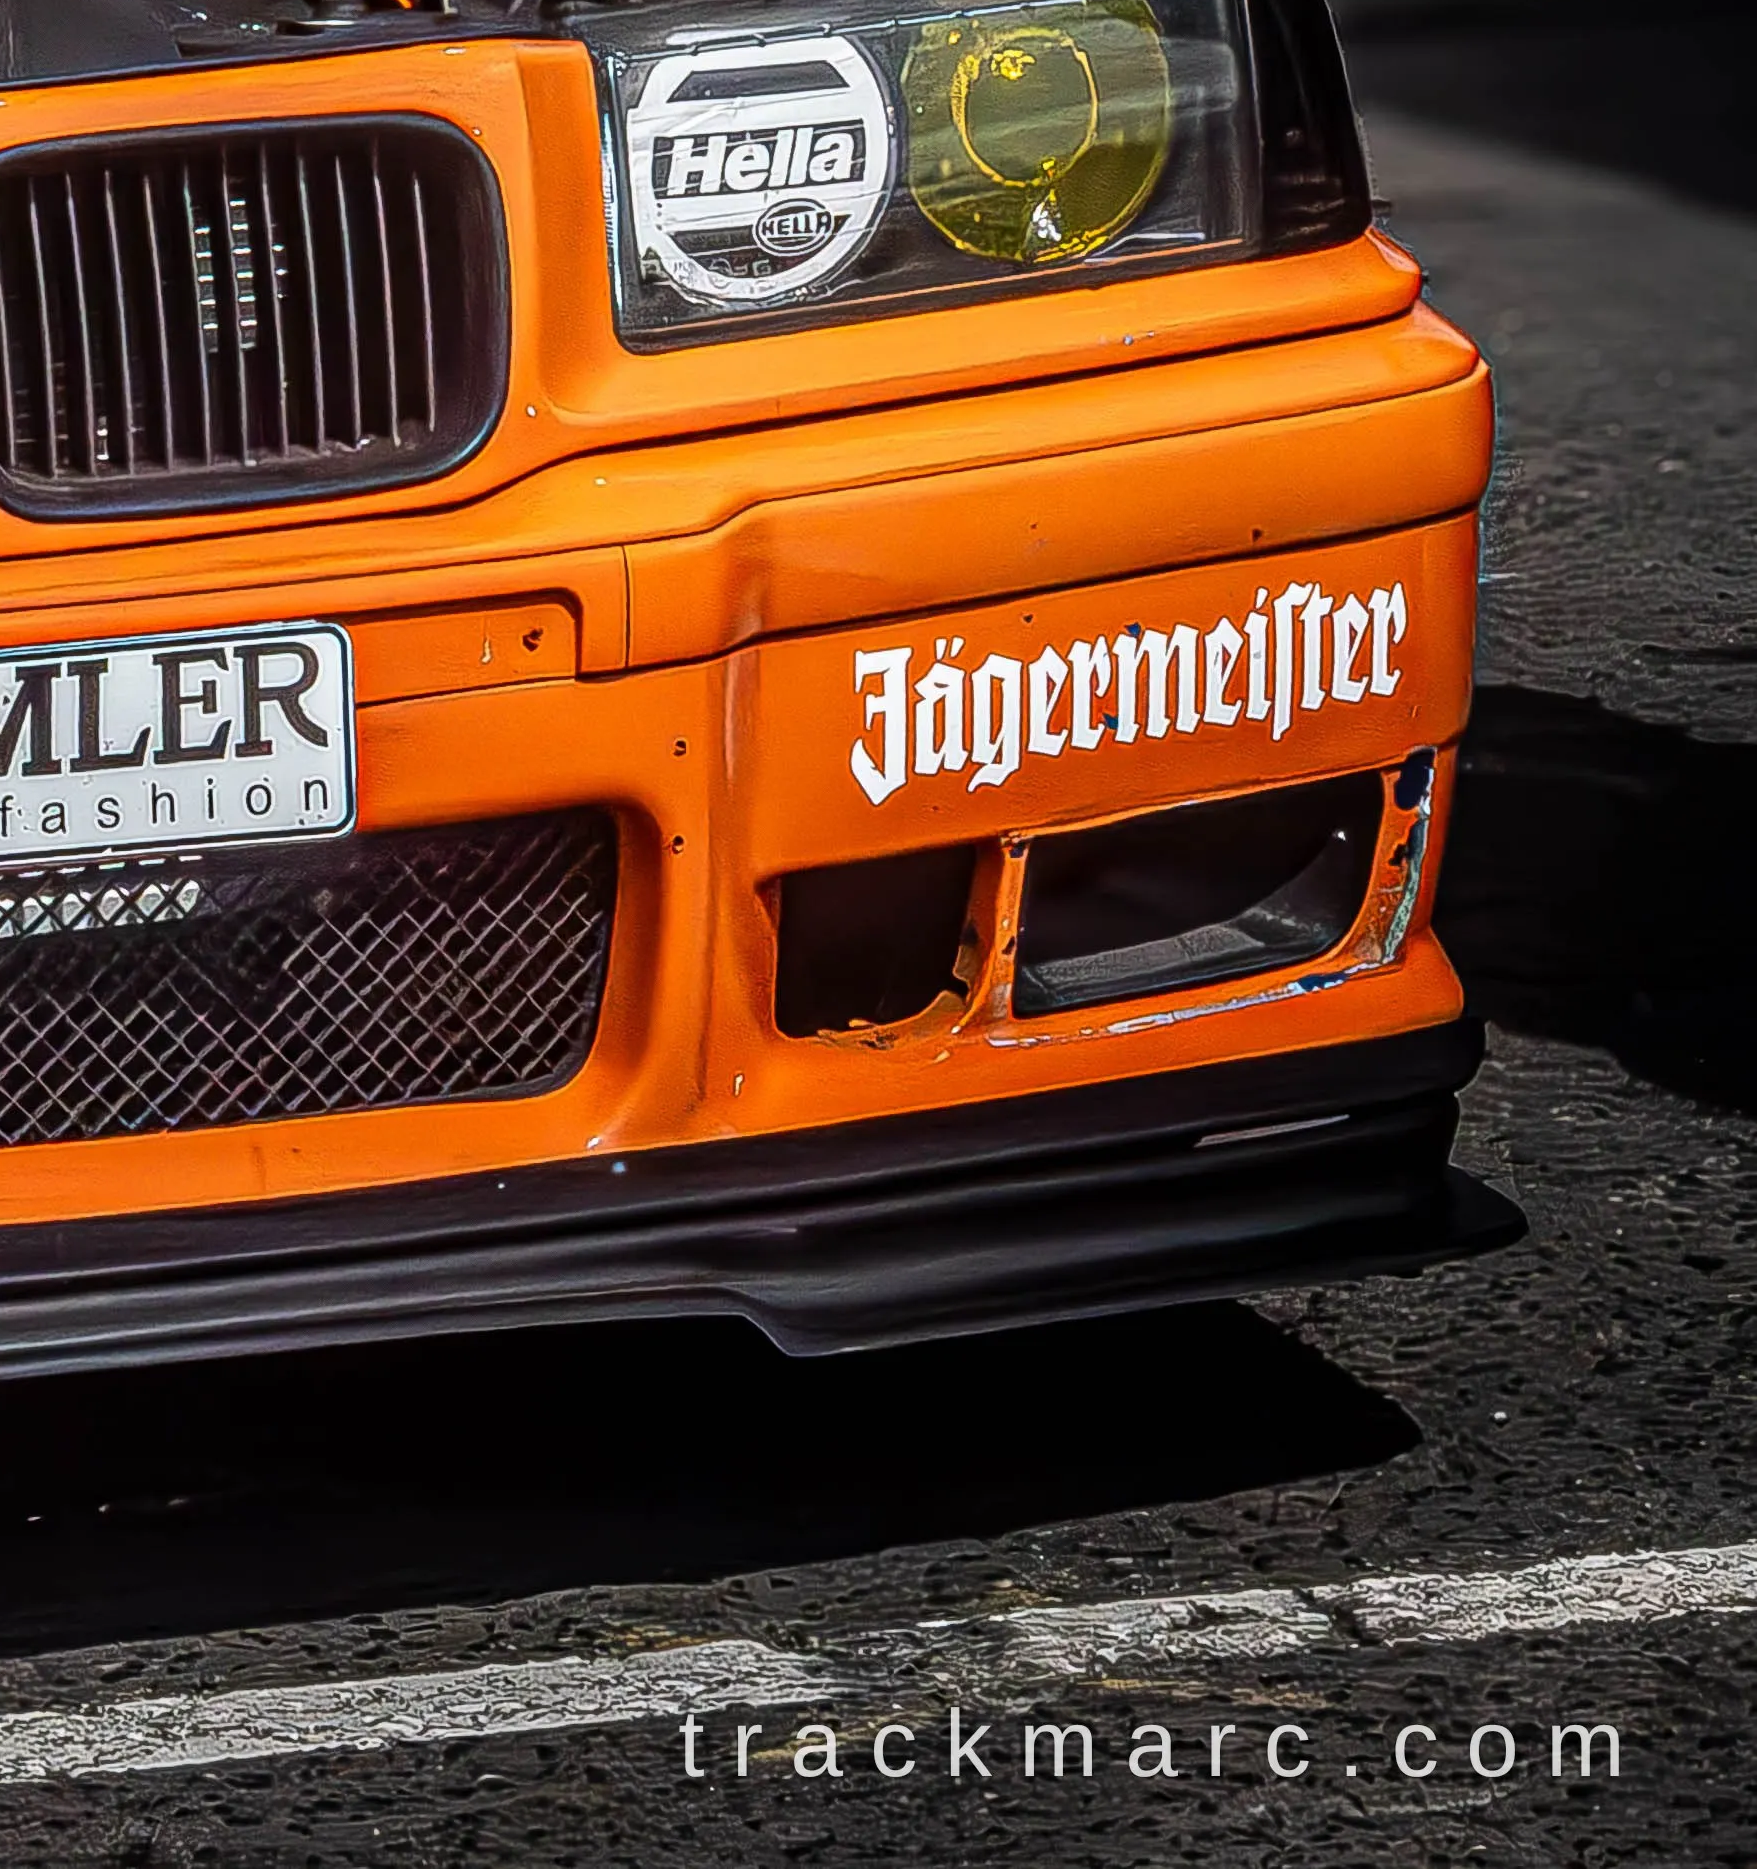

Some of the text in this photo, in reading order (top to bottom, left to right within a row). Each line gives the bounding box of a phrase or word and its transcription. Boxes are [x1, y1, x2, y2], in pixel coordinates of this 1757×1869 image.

[666, 127, 855, 198] Hella
[758, 209, 834, 238] HELLA
[849, 581, 1407, 806] Jägermeister
